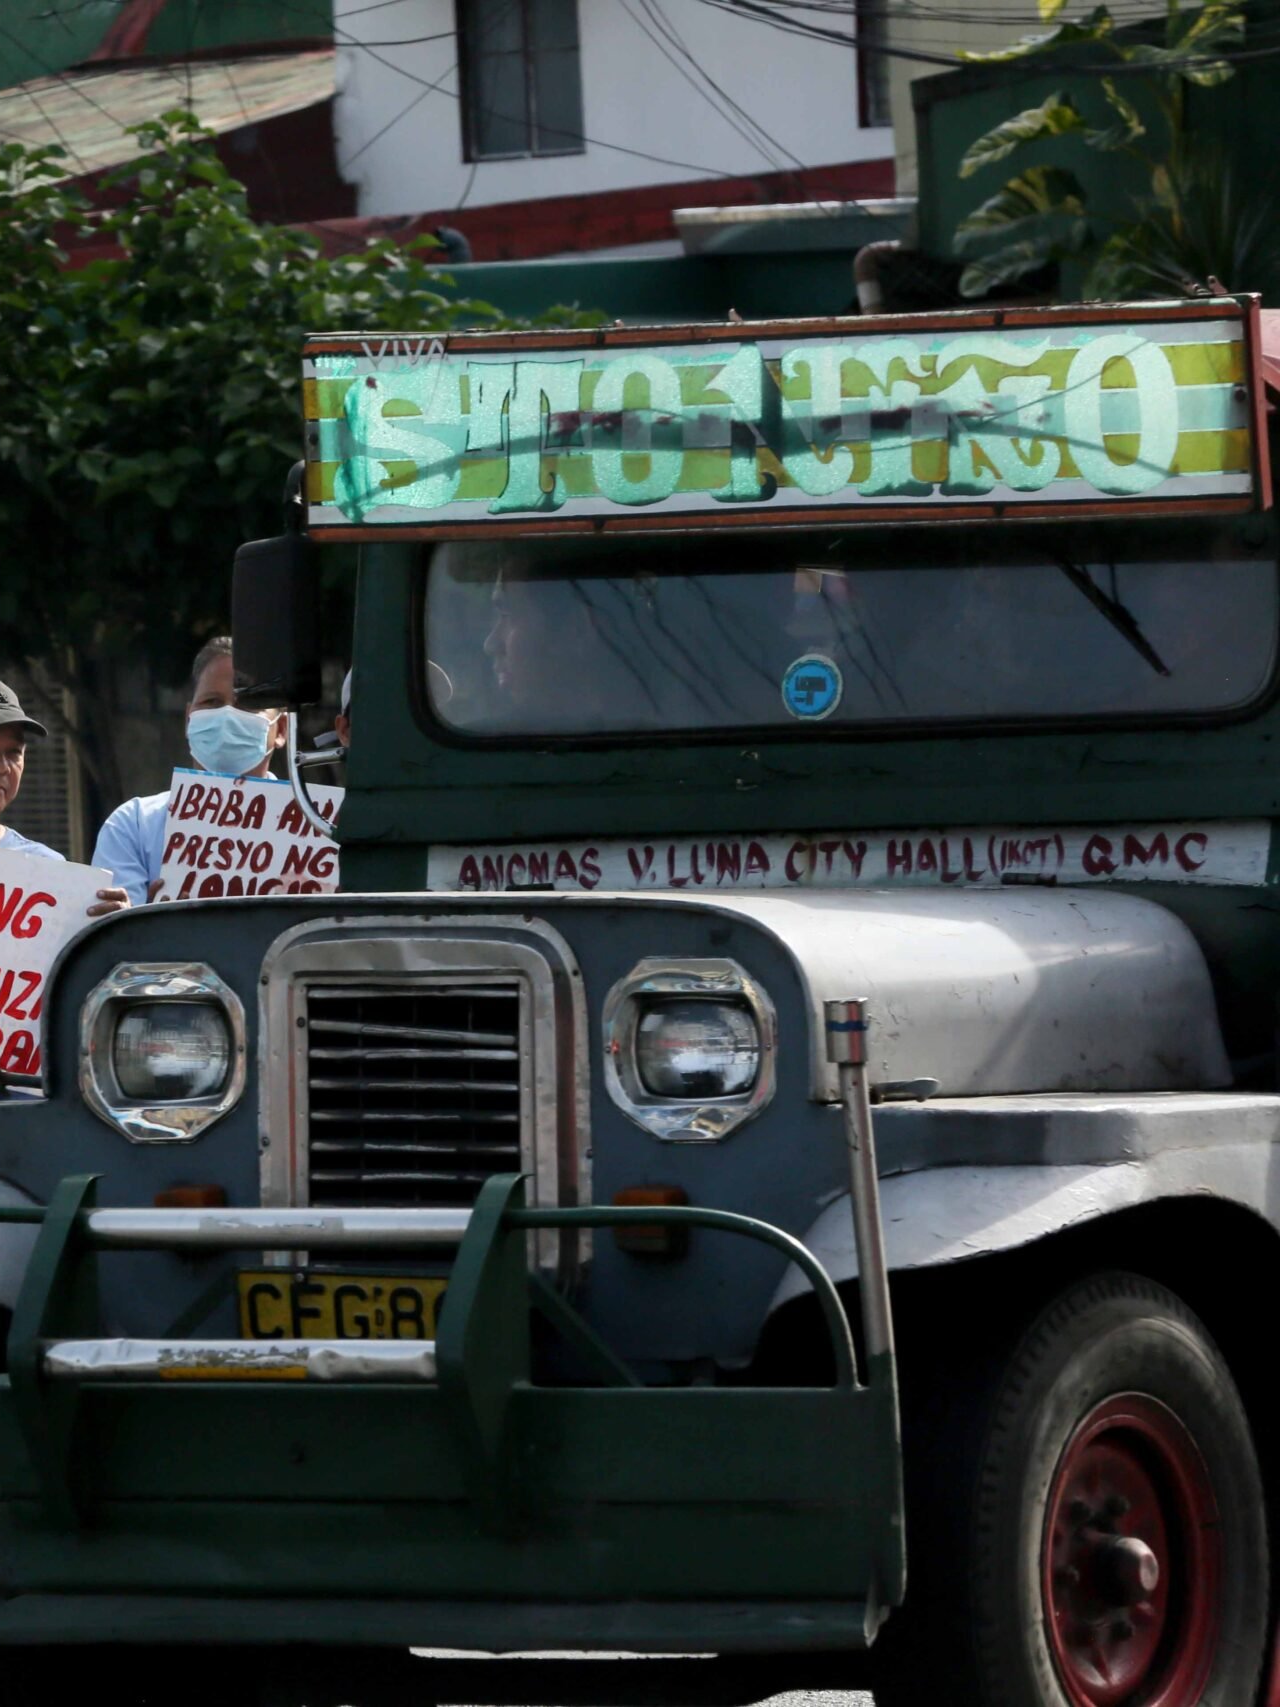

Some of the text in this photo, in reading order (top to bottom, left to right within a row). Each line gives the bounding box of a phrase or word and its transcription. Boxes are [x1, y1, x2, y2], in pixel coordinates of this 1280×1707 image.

[361, 339, 450, 371] VIVA
[168, 783, 267, 830] IBABA
[161, 831, 339, 878] PRESYO NG
[667, 841, 771, 888] LUNA
[784, 839, 868, 882] CITY
[888, 836, 986, 883] HALL
[1082, 831, 1208, 874] QMC
